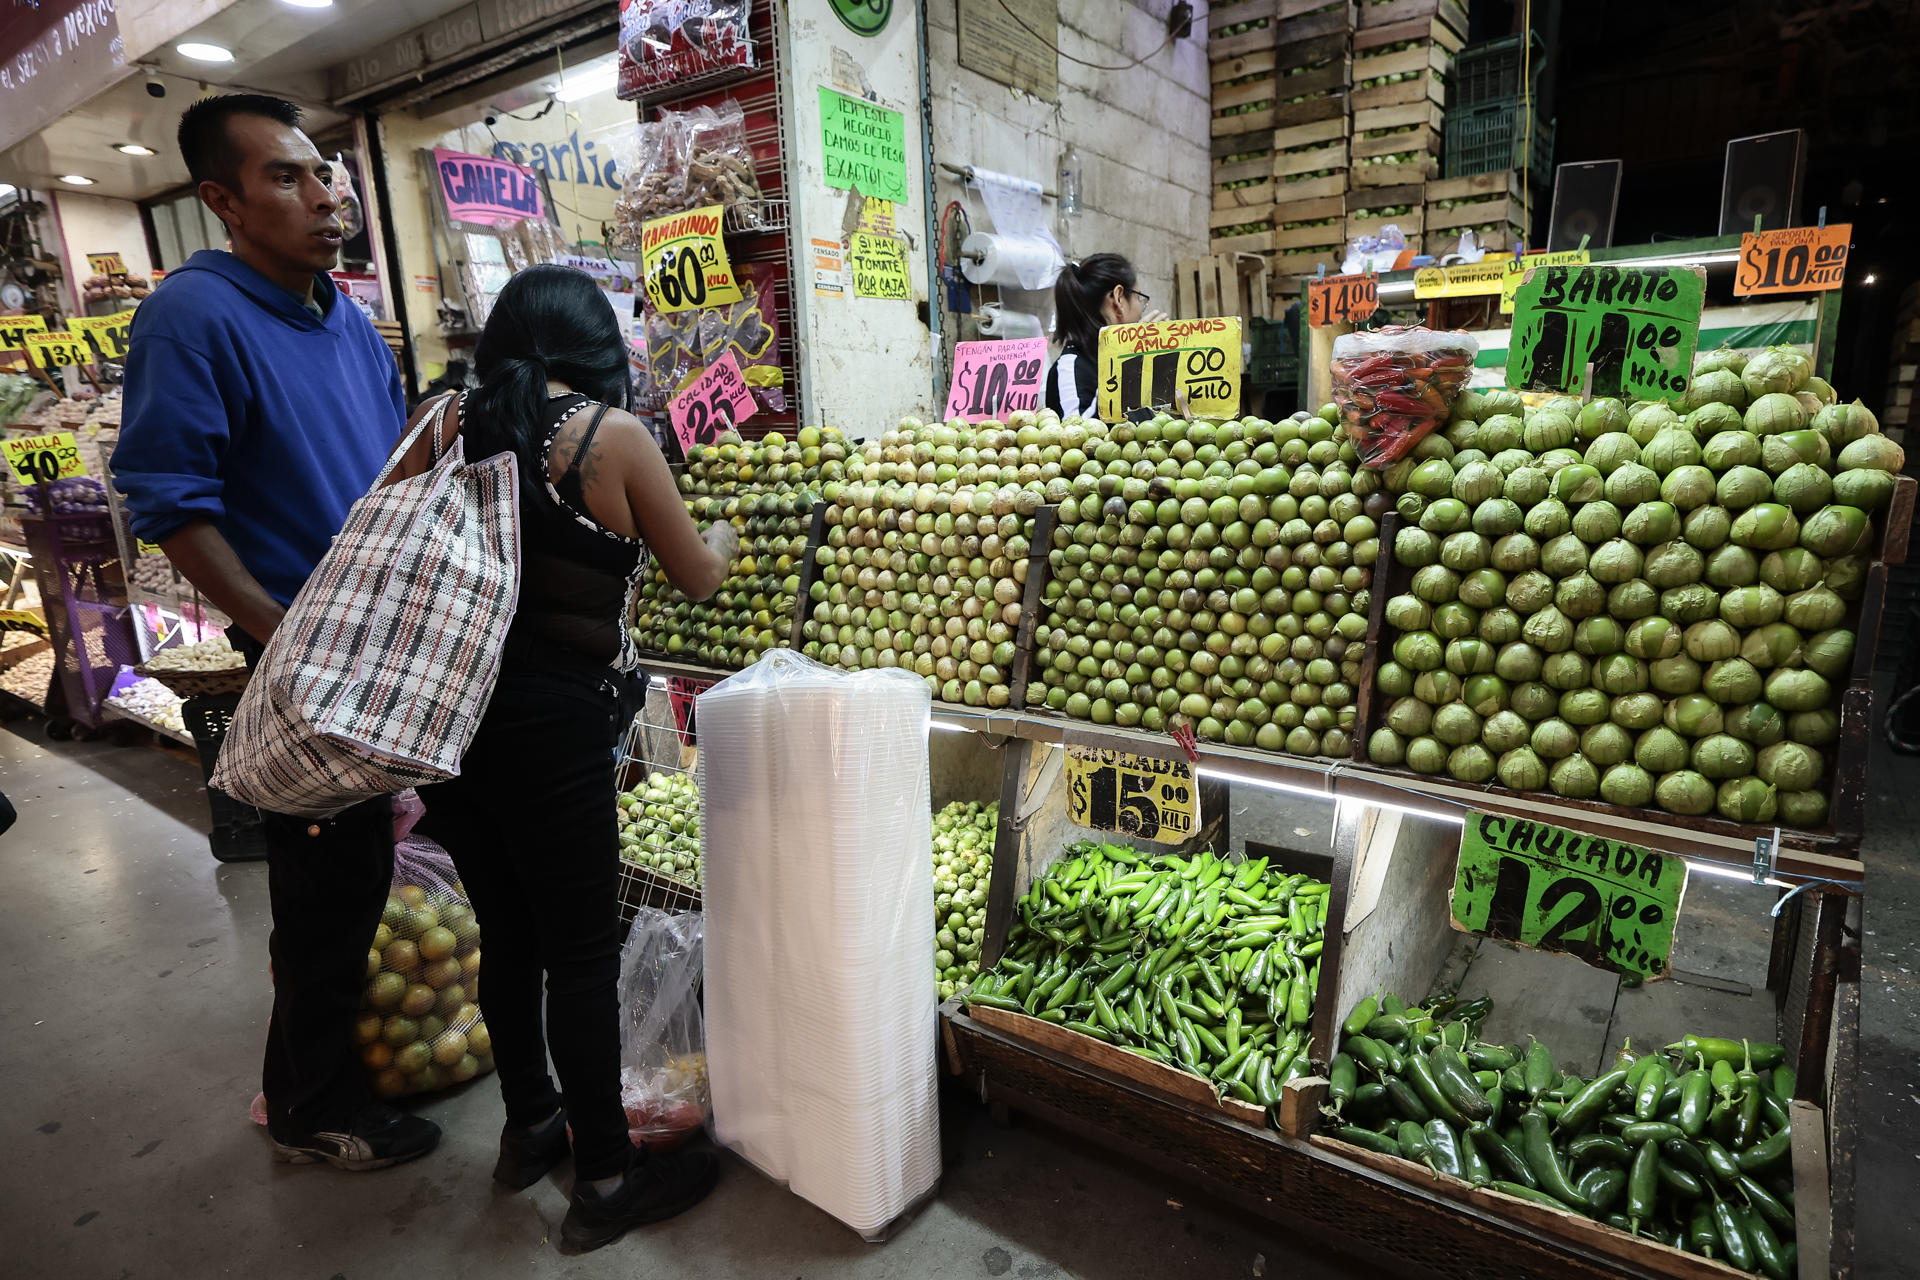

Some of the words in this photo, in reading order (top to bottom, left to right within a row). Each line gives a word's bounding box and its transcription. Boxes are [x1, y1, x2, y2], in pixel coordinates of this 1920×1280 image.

[843, 117, 891, 142] NEGOCIO
[824, 129, 860, 152] DAMOS
[863, 142, 877, 158] EL
[881, 145, 905, 163] PESO
[440, 161, 538, 215] CANELA
[643, 214, 719, 252] TAMARINDO
[859, 235, 871, 249] SI
[875, 239, 895, 253] HAY
[813, 247, 840, 258] CENSADO
[1509, 259, 1526, 273] DE
[1552, 253, 1582, 265] MEJOR
[854, 256, 902, 274] TOMATE
[1804, 266, 1845, 284] KILO
[707, 273, 729, 288] KILO
[858, 272, 877, 292] POR
[879, 277, 907, 297] CAJA
[1538, 265, 1678, 307] BARATO
[1167, 318, 1226, 337] SOMOS
[998, 342, 1016, 353] PARA
[1018, 342, 1031, 351] QUE
[1032, 341, 1042, 350] SE
[678, 362, 730, 411] CALIDAD
[1630, 361, 1687, 392] KILO
[730, 381, 747, 402] KILO
[1004, 391, 1039, 413] KILO
[1187, 380, 1231, 404] KILO
[9, 435, 62, 453] MALLA
[1161, 810, 1191, 832] KILO
[1479, 814, 1663, 889] CHULADA
